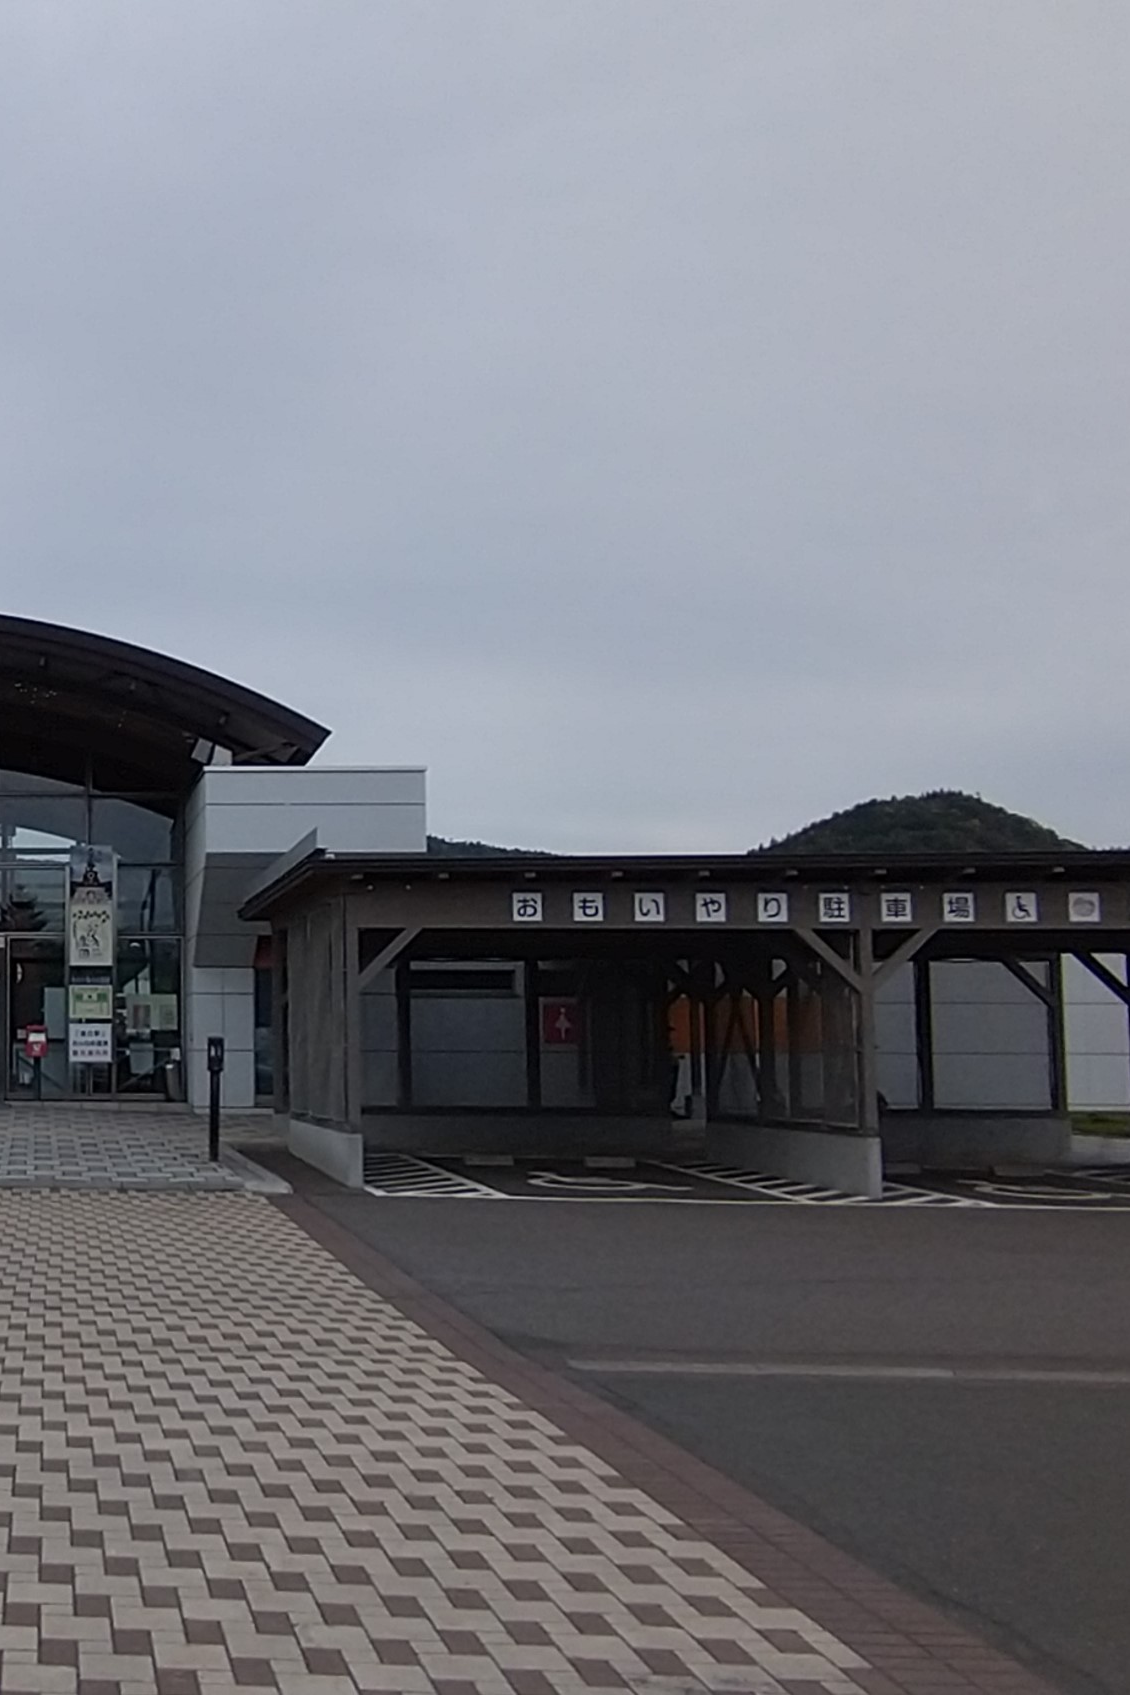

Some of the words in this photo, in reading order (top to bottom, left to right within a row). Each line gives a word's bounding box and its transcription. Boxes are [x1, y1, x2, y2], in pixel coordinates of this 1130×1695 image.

[517, 897, 971, 919] おもいやり駐車場
